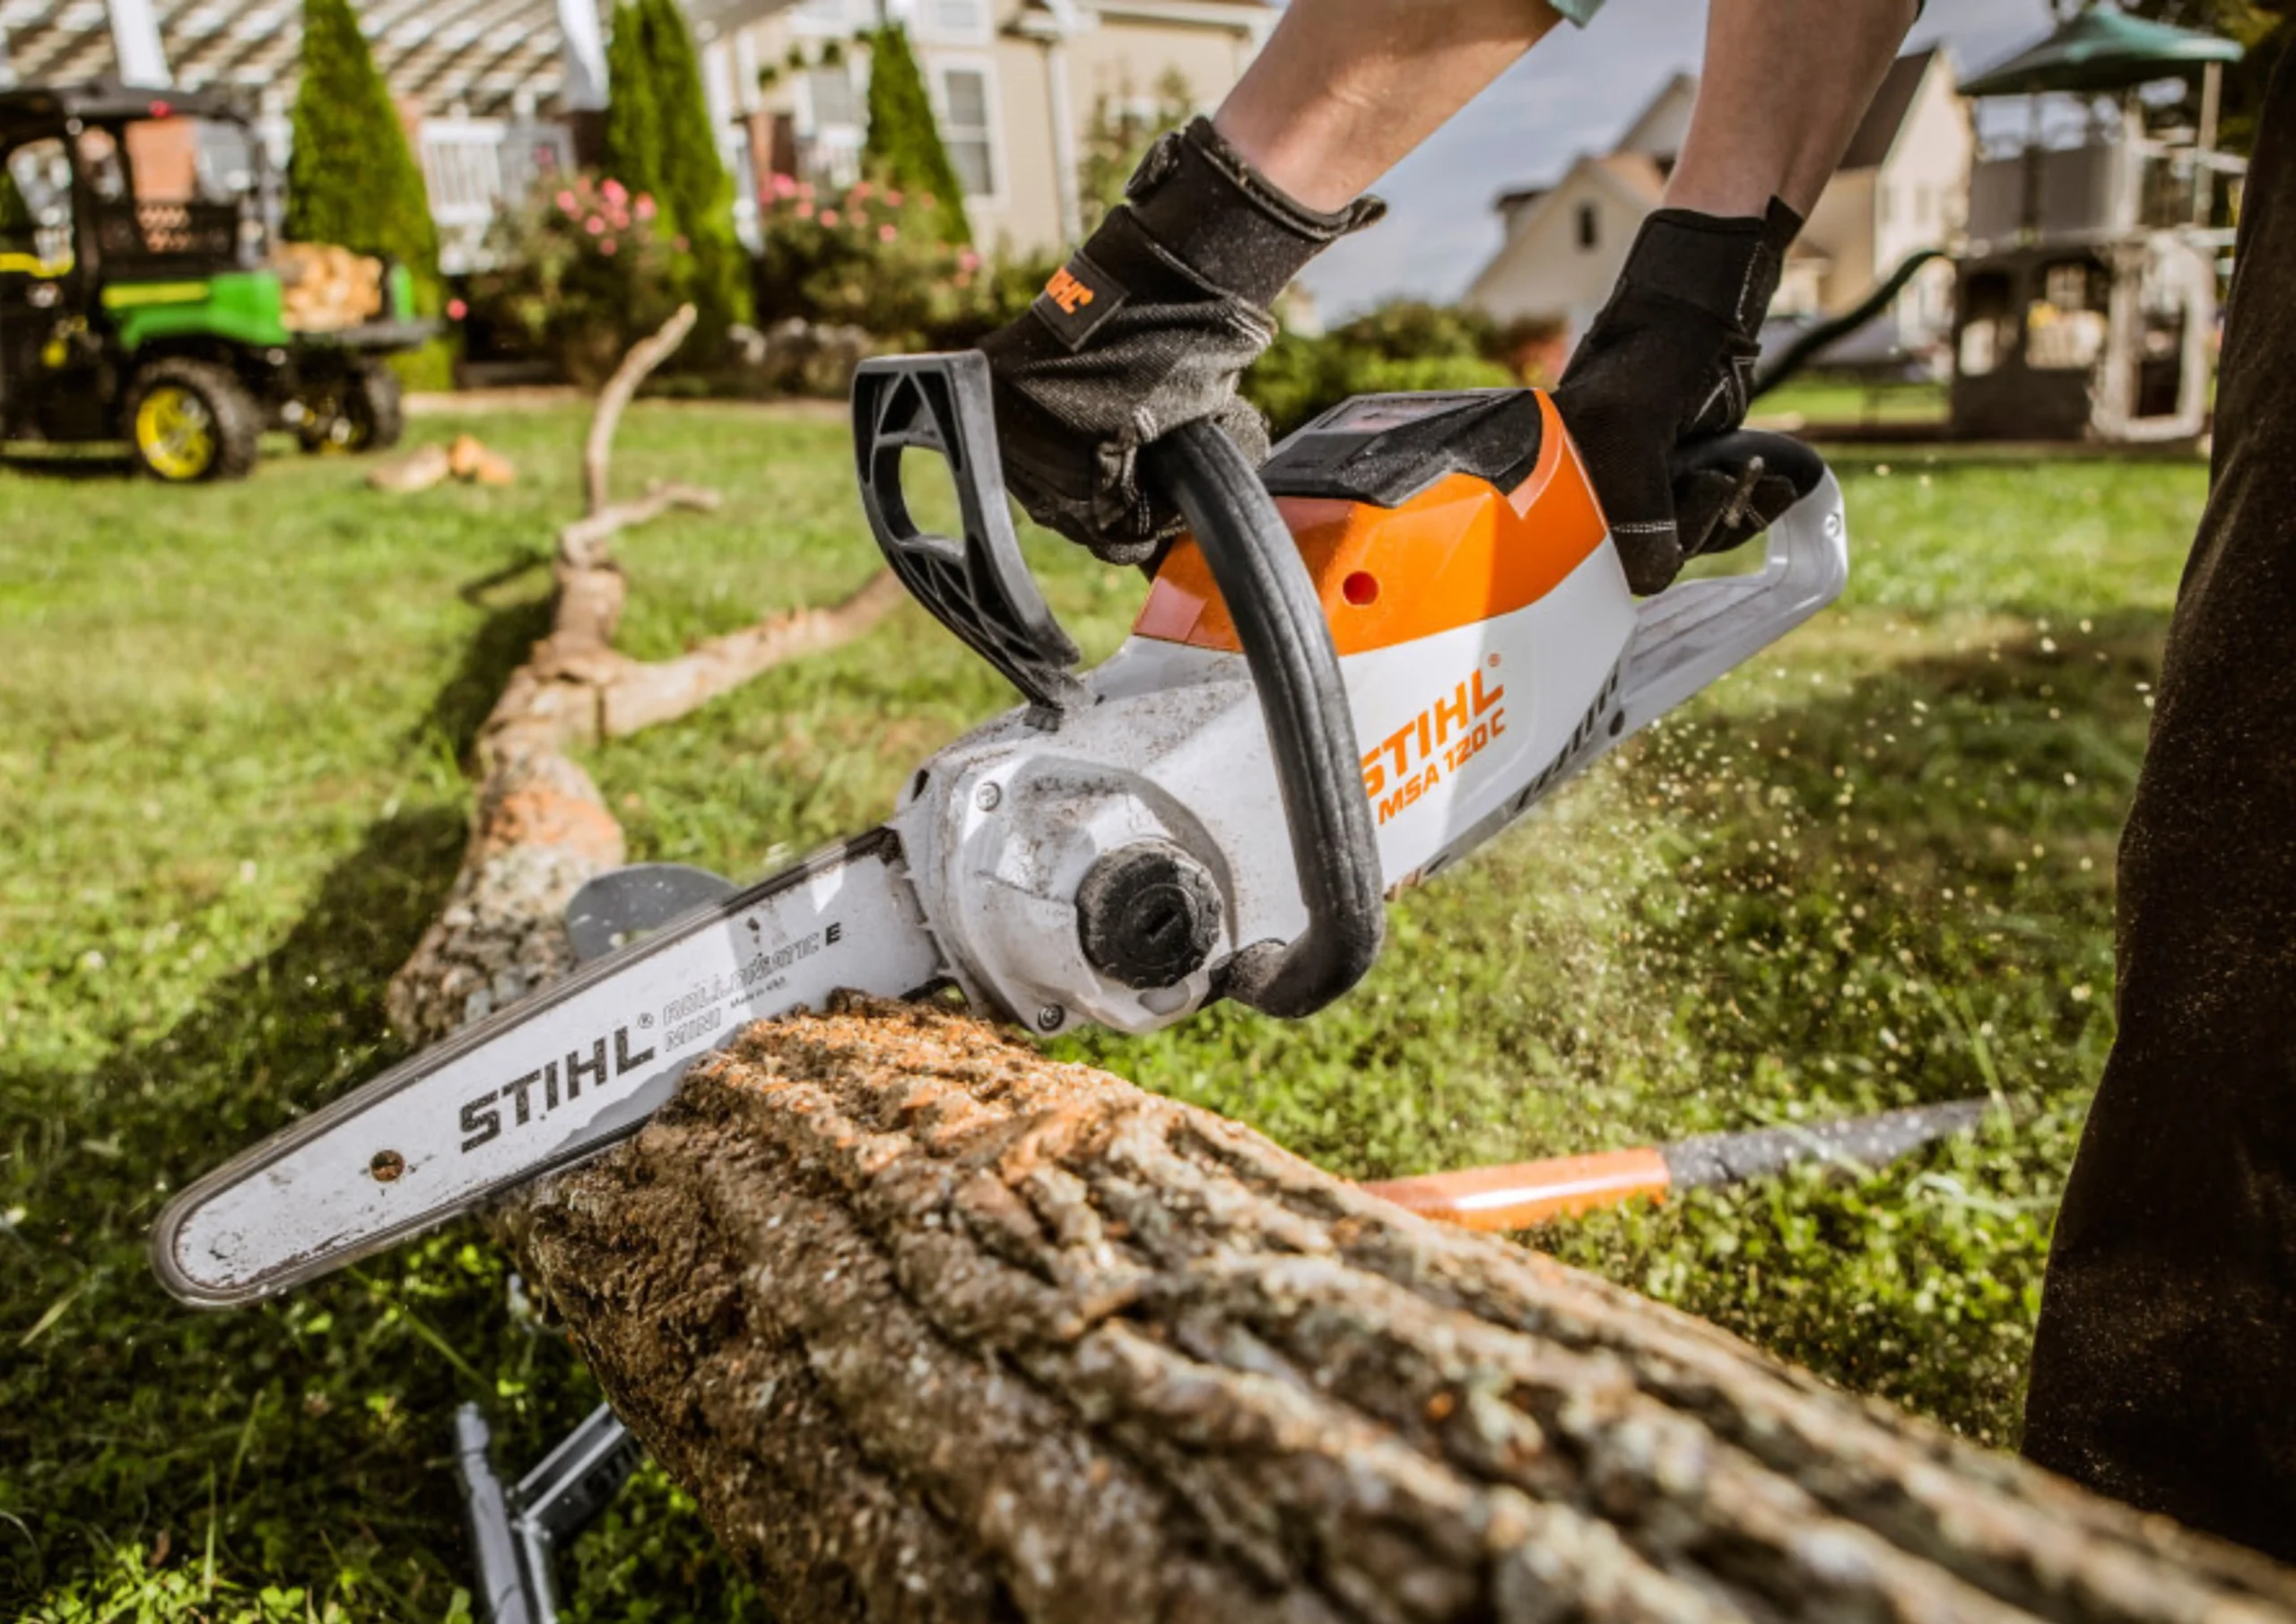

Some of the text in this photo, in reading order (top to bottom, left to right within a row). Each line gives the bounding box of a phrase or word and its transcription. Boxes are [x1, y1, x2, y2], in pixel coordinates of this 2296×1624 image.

[1360, 668, 1504, 799] STIHL
[1378, 762, 1439, 825] MSA
[826, 922, 841, 945] E
[460, 1026, 656, 1153] STIHL
